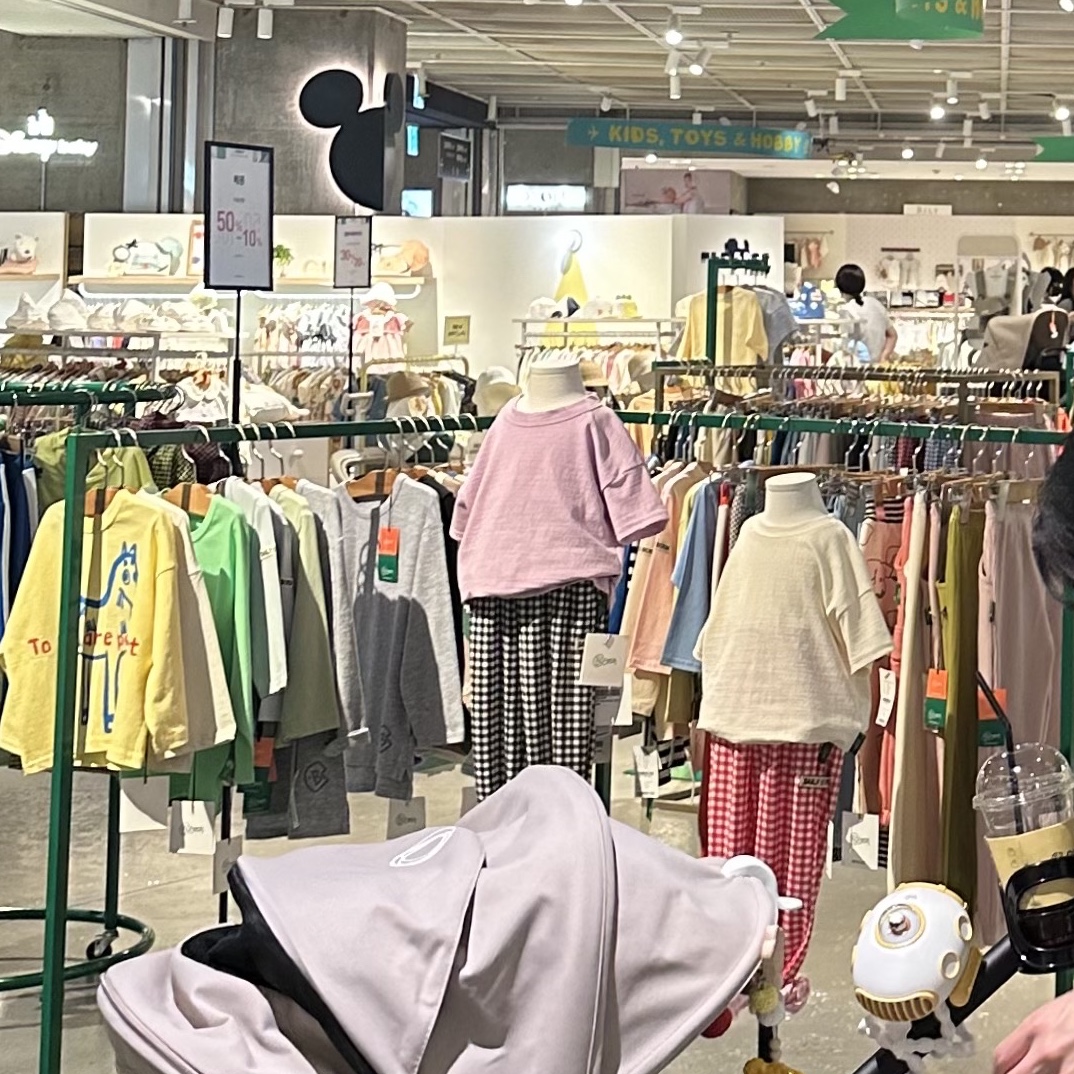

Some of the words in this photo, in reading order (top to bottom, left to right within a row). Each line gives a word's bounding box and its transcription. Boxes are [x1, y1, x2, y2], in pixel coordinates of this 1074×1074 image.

[609, 125, 664, 146] KIDS,
[670, 128, 727, 146] TOYS
[734, 131, 745, 146] &
[751, 133, 801, 153] HOBBY
[28, 638, 52, 655] To
